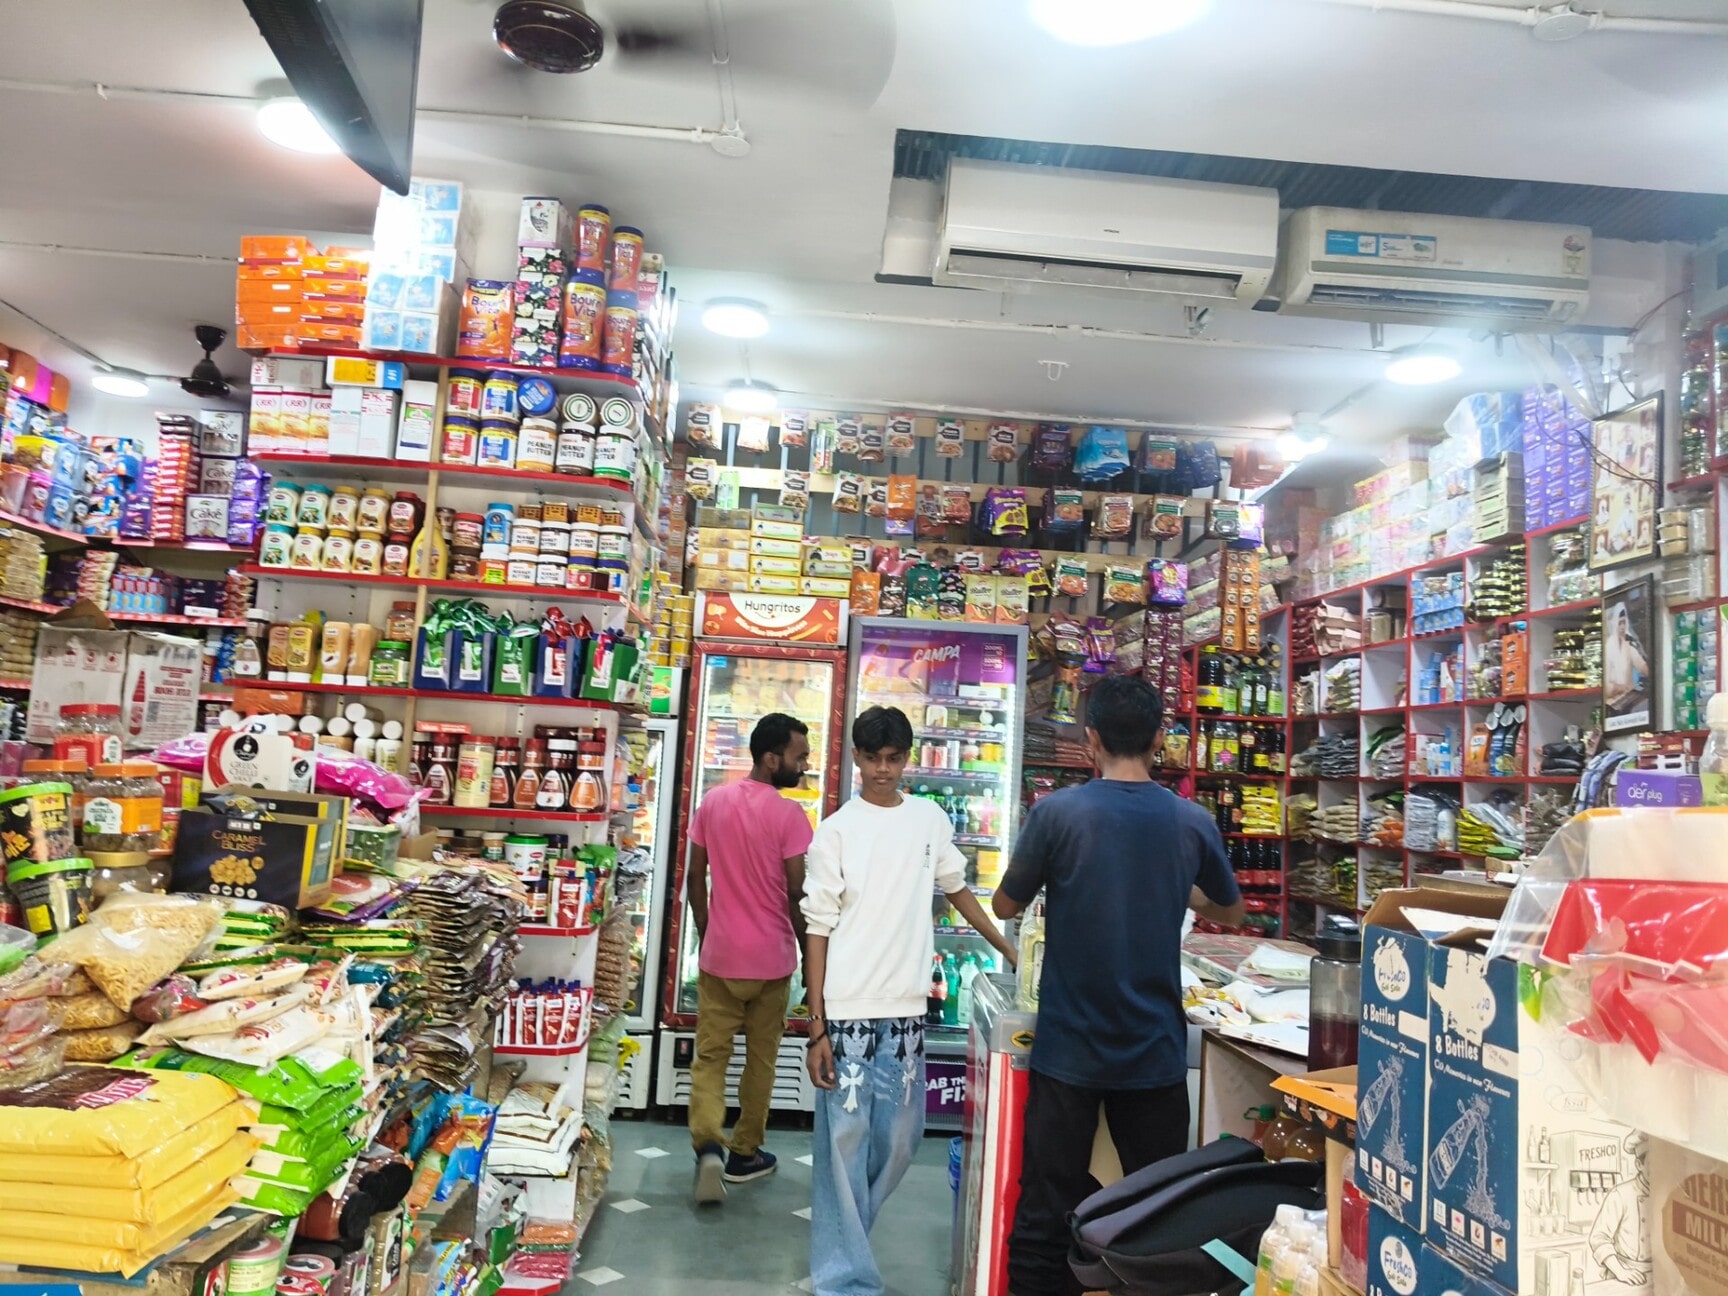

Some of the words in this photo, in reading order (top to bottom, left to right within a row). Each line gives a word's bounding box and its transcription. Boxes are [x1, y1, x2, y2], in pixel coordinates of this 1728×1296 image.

[744, 600, 801, 614] Hungritos
[913, 645, 961, 663] CAMPA
[1647, 790, 1663, 803] plug
[211, 829, 268, 846] CARAMEL
[220, 840, 256, 853] BLISS
[1363, 1004, 1369, 1021] 8
[1370, 1004, 1396, 1027] Bottles
[1435, 1034, 1442, 1054] 8
[1444, 1035, 1479, 1062] Bottles
[1579, 1144, 1617, 1163] FRESHCO
